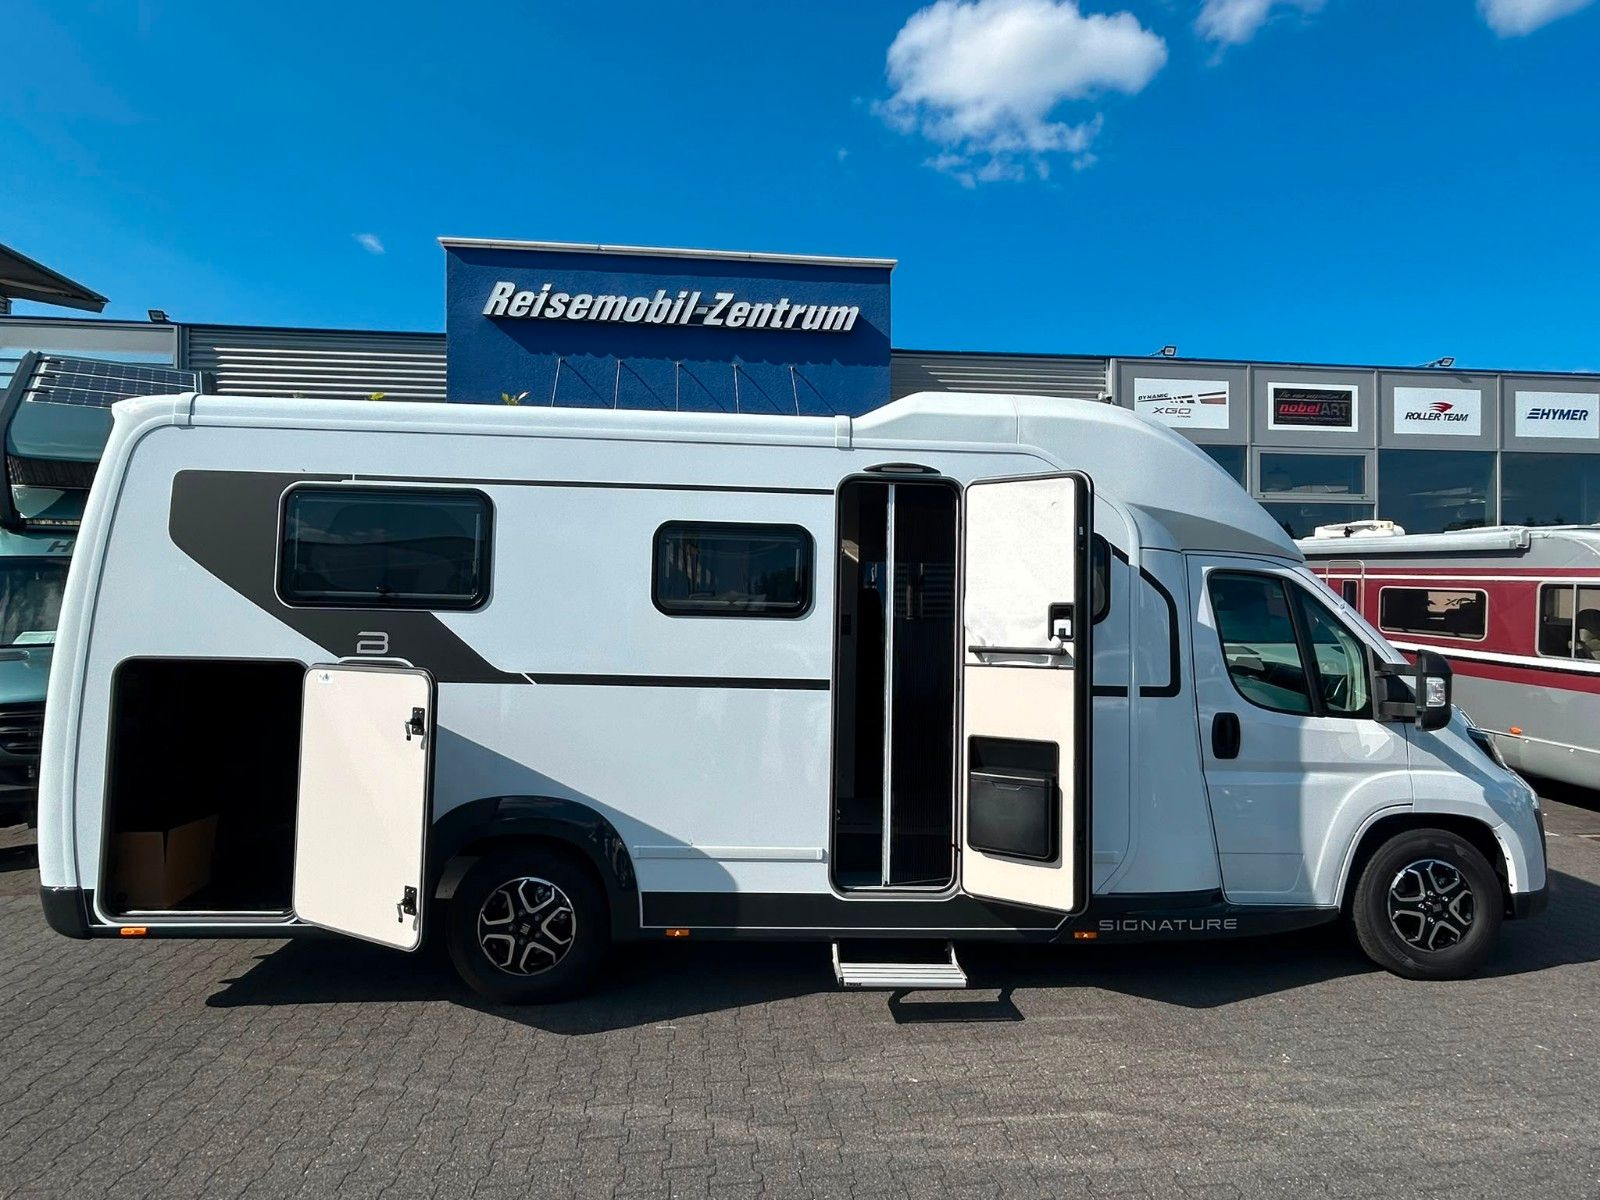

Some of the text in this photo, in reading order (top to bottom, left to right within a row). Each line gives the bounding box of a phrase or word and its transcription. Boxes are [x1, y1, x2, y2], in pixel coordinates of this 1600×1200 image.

[482, 281, 860, 331] Reisemobil-Zentrum
[1138, 393, 1169, 401] DYNAMIC
[1152, 407, 1192, 415] XGO
[1540, 408, 1589, 421] HYMER
[1405, 412, 1469, 422] ROLLER TEAM
[1099, 918, 1238, 931] SIGNATURE
